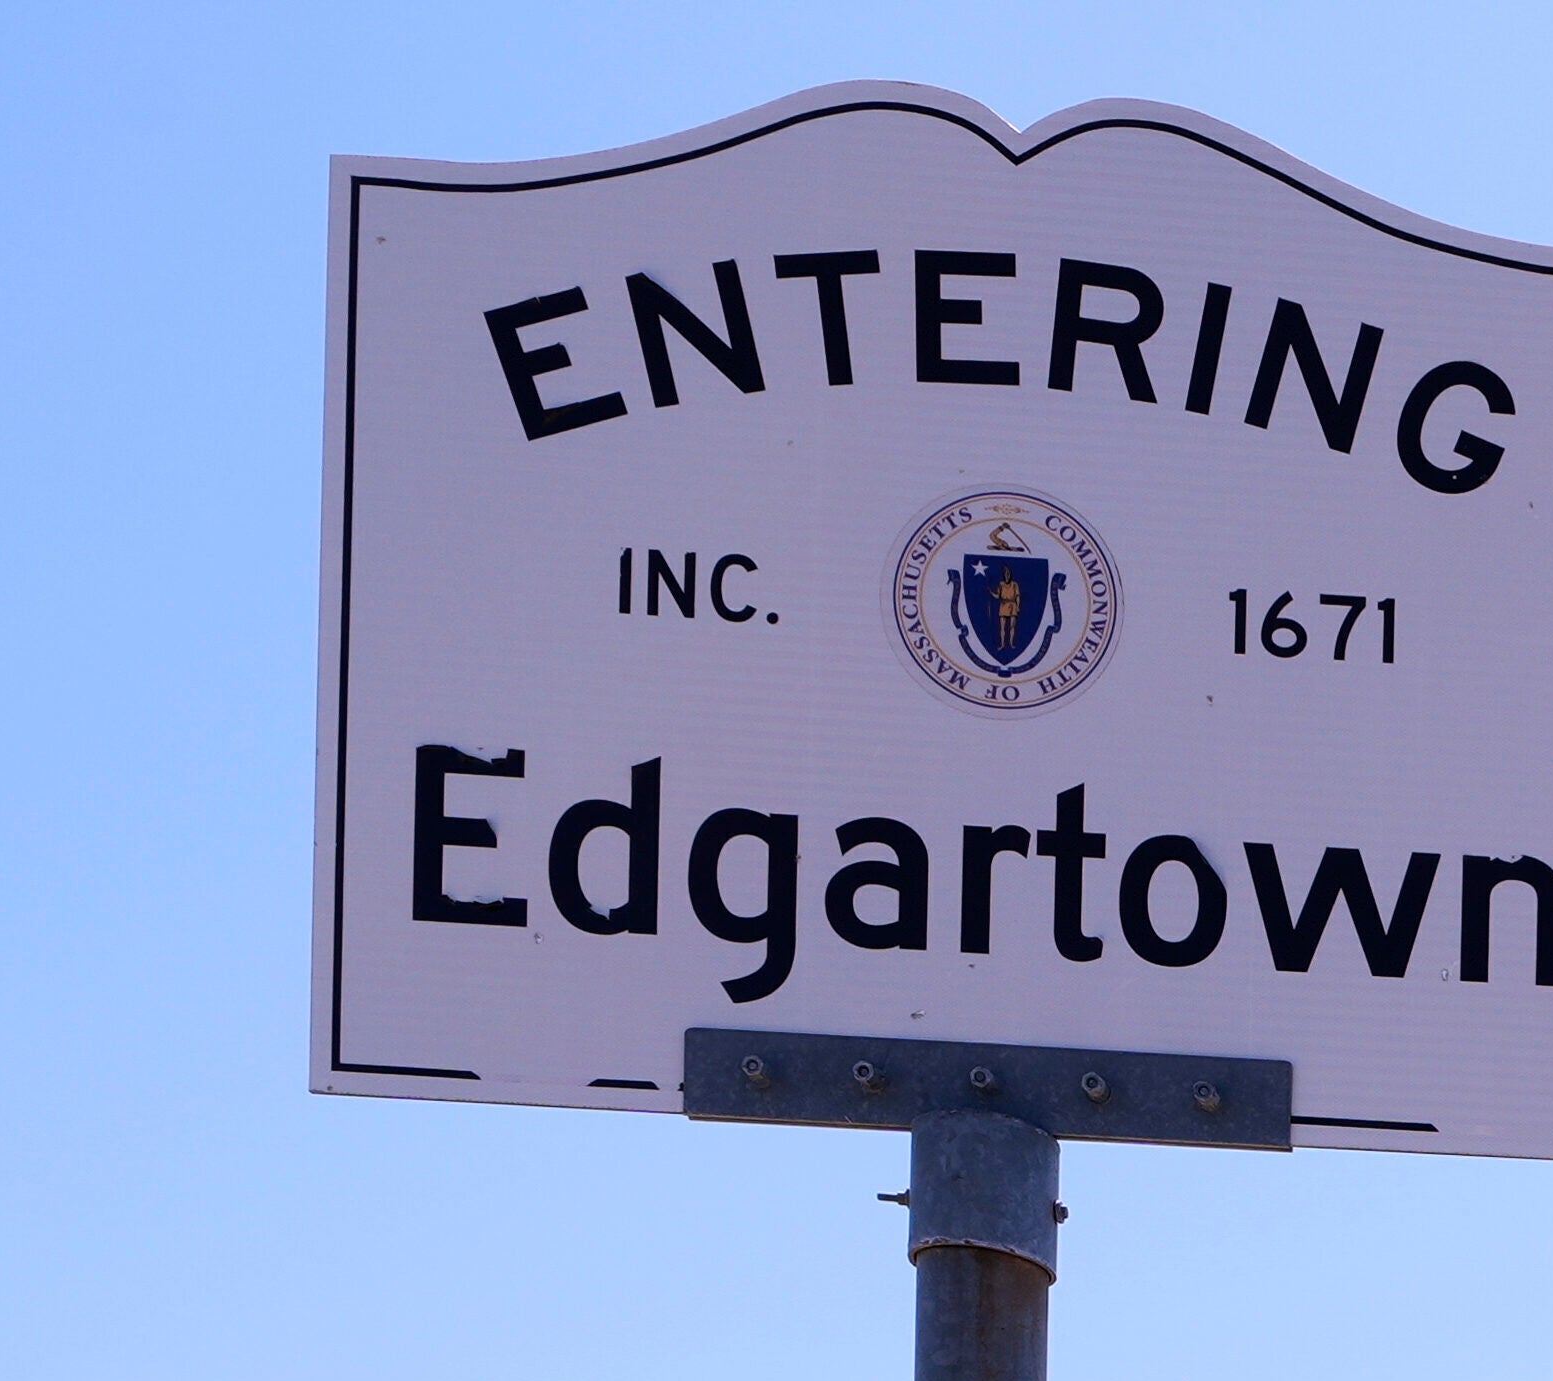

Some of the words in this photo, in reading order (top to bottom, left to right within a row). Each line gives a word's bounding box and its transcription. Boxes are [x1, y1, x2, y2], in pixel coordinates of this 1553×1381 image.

[482, 248, 1517, 494] ENTERING
[617, 546, 781, 625] INC.
[1228, 588, 1396, 665] 1671
[901, 506, 974, 691] MASSACHUSETTS
[1036, 514, 1109, 696] COMMONWEALTH
[984, 684, 1021, 702] OF
